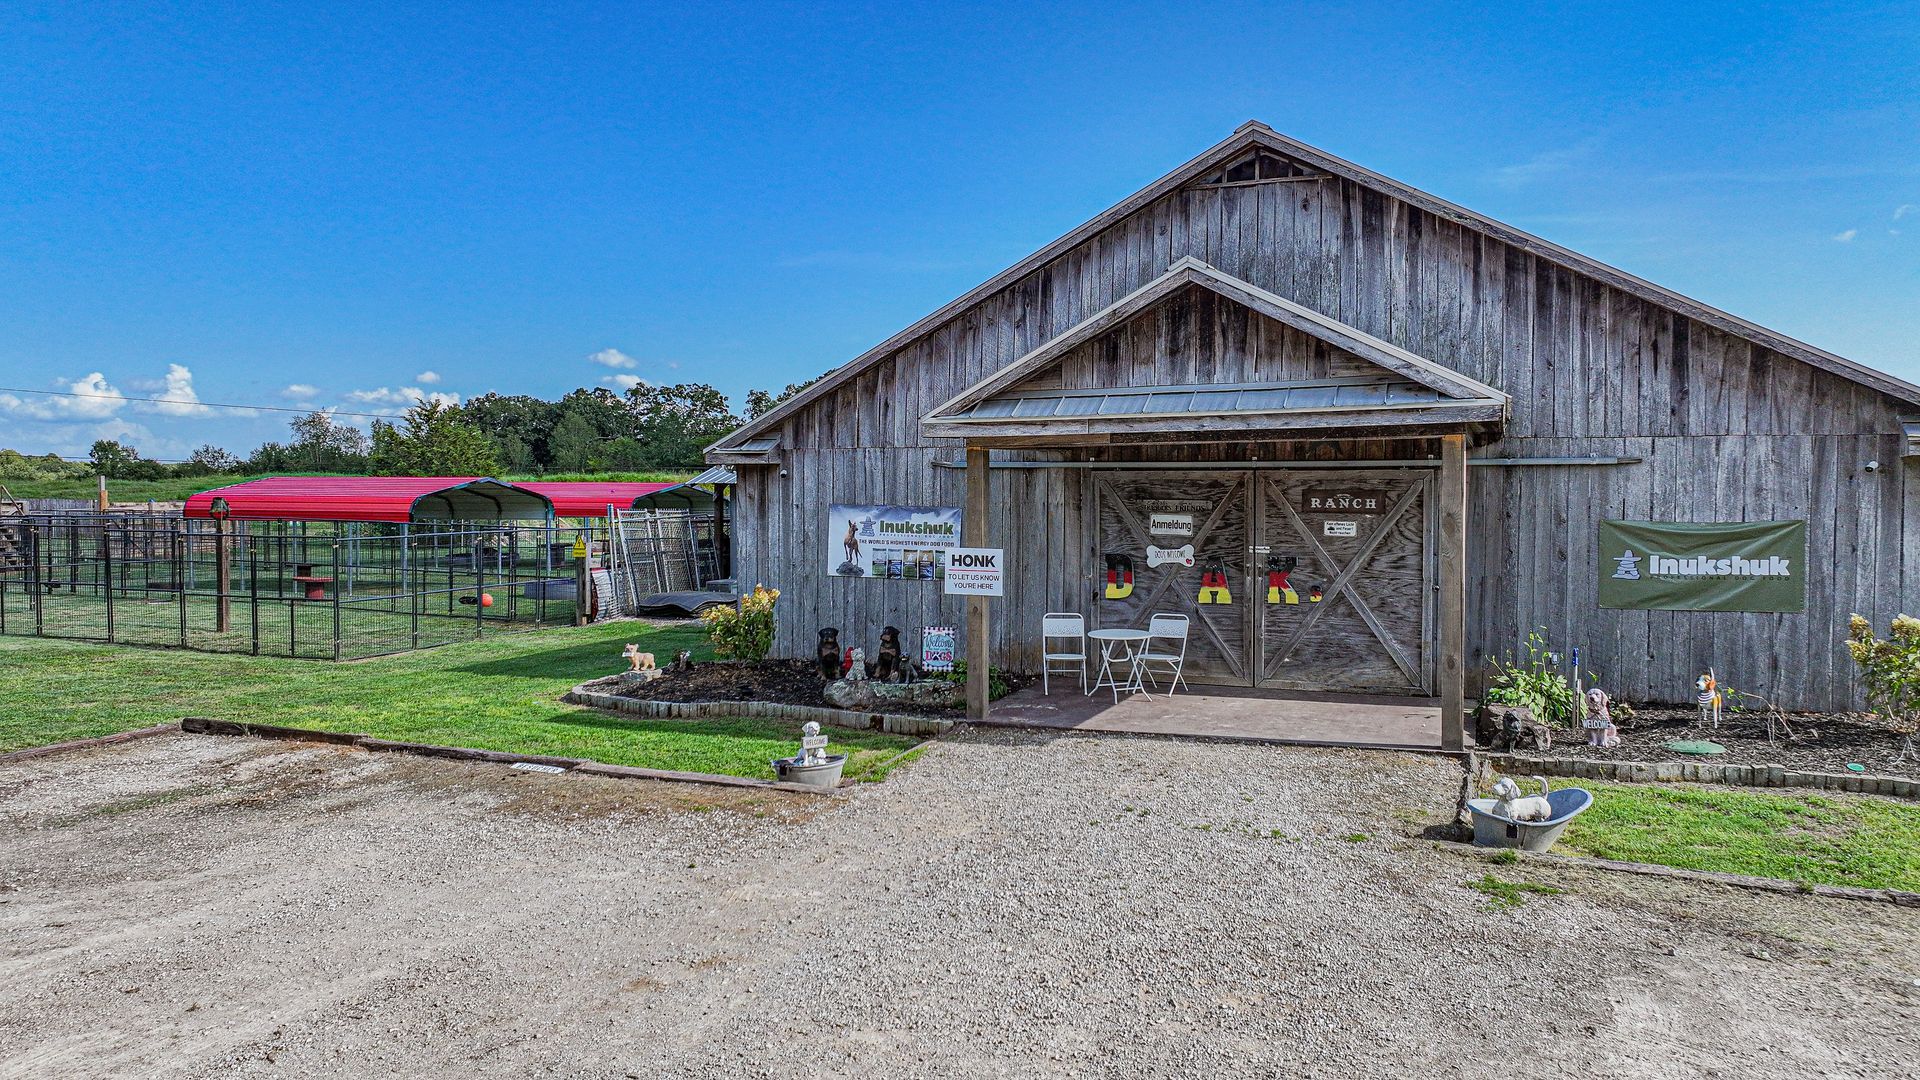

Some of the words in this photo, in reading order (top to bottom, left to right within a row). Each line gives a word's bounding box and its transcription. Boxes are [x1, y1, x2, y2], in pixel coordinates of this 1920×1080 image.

[1310, 498, 1377, 509] RANCH
[879, 520, 954, 535] Inukshuk
[1151, 519, 1192, 532] Anmeldung
[951, 554, 996, 568] HONK
[1649, 555, 1790, 576] Inukshuk
[980, 574, 1000, 582] KNOW
[1582, 719, 1611, 729] WELCOME
